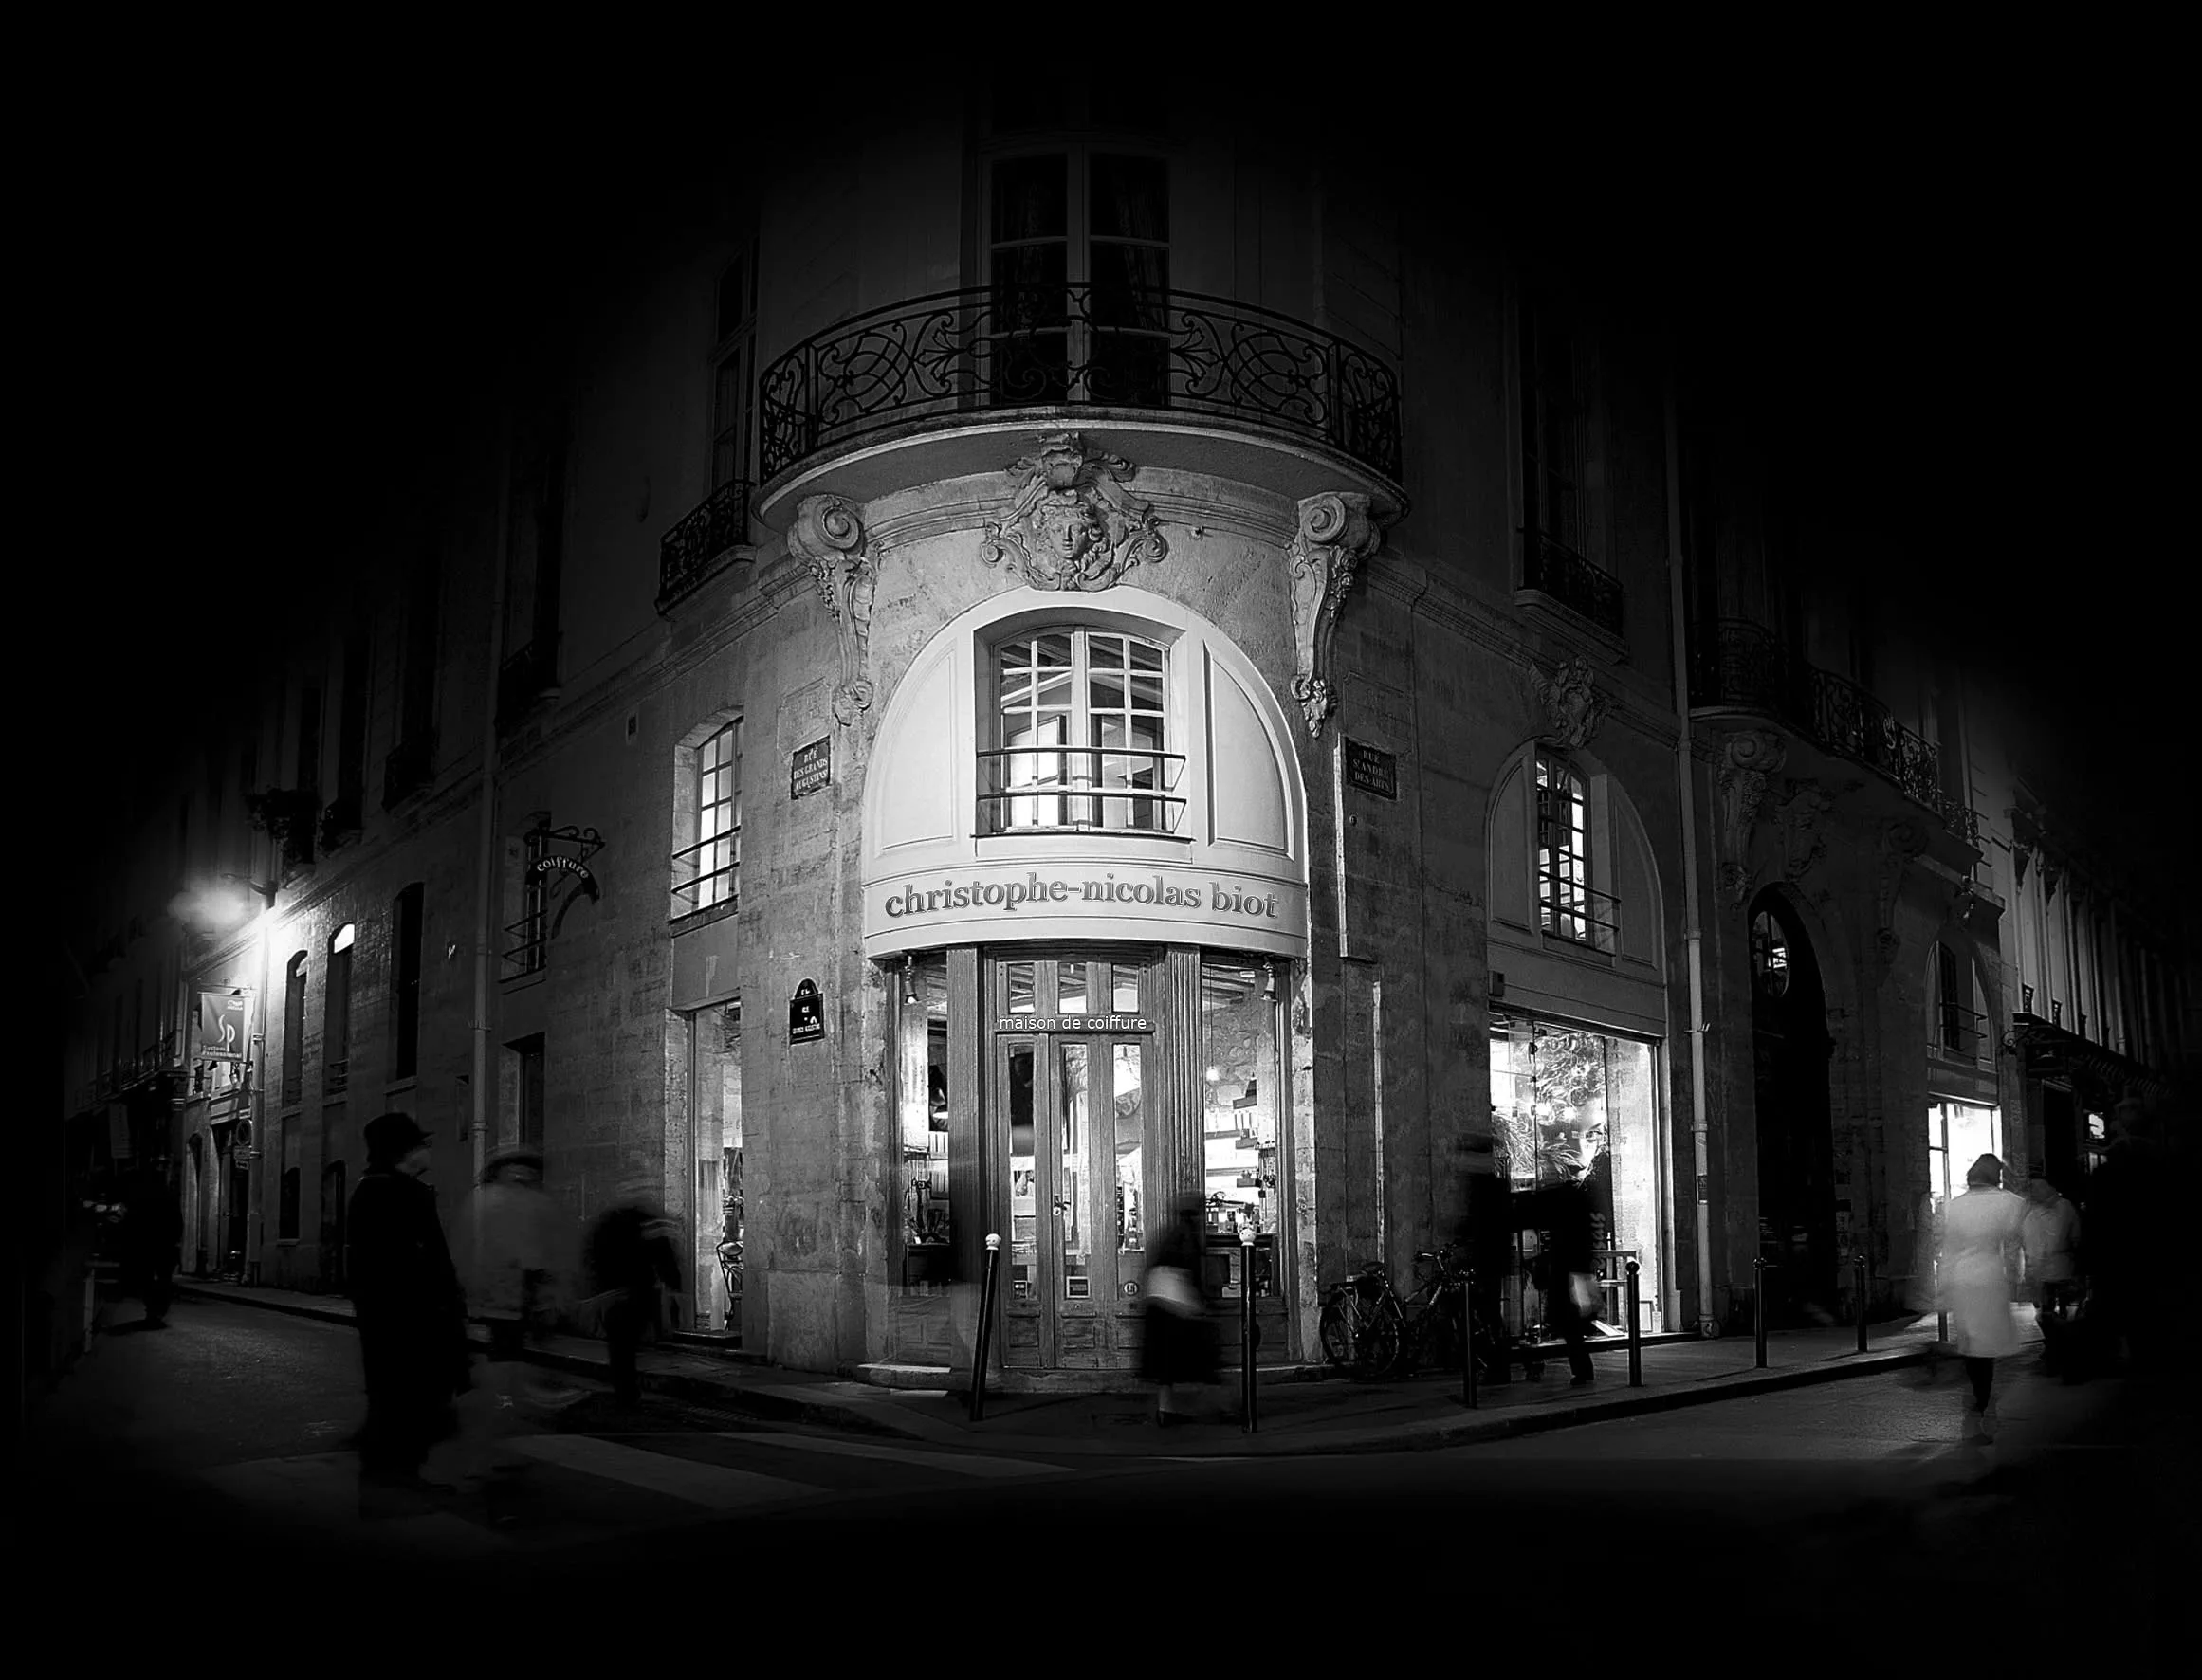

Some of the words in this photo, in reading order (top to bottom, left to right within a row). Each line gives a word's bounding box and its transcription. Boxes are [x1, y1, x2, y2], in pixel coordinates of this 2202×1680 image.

[536, 856, 590, 880] coiffure
[885, 871, 1202, 919] christophe-nicolas
[1209, 881, 1279, 918] biot
[999, 1016, 1056, 1030] maison
[1061, 1015, 1082, 1030] de
[1087, 1014, 1147, 1030] coiffure
